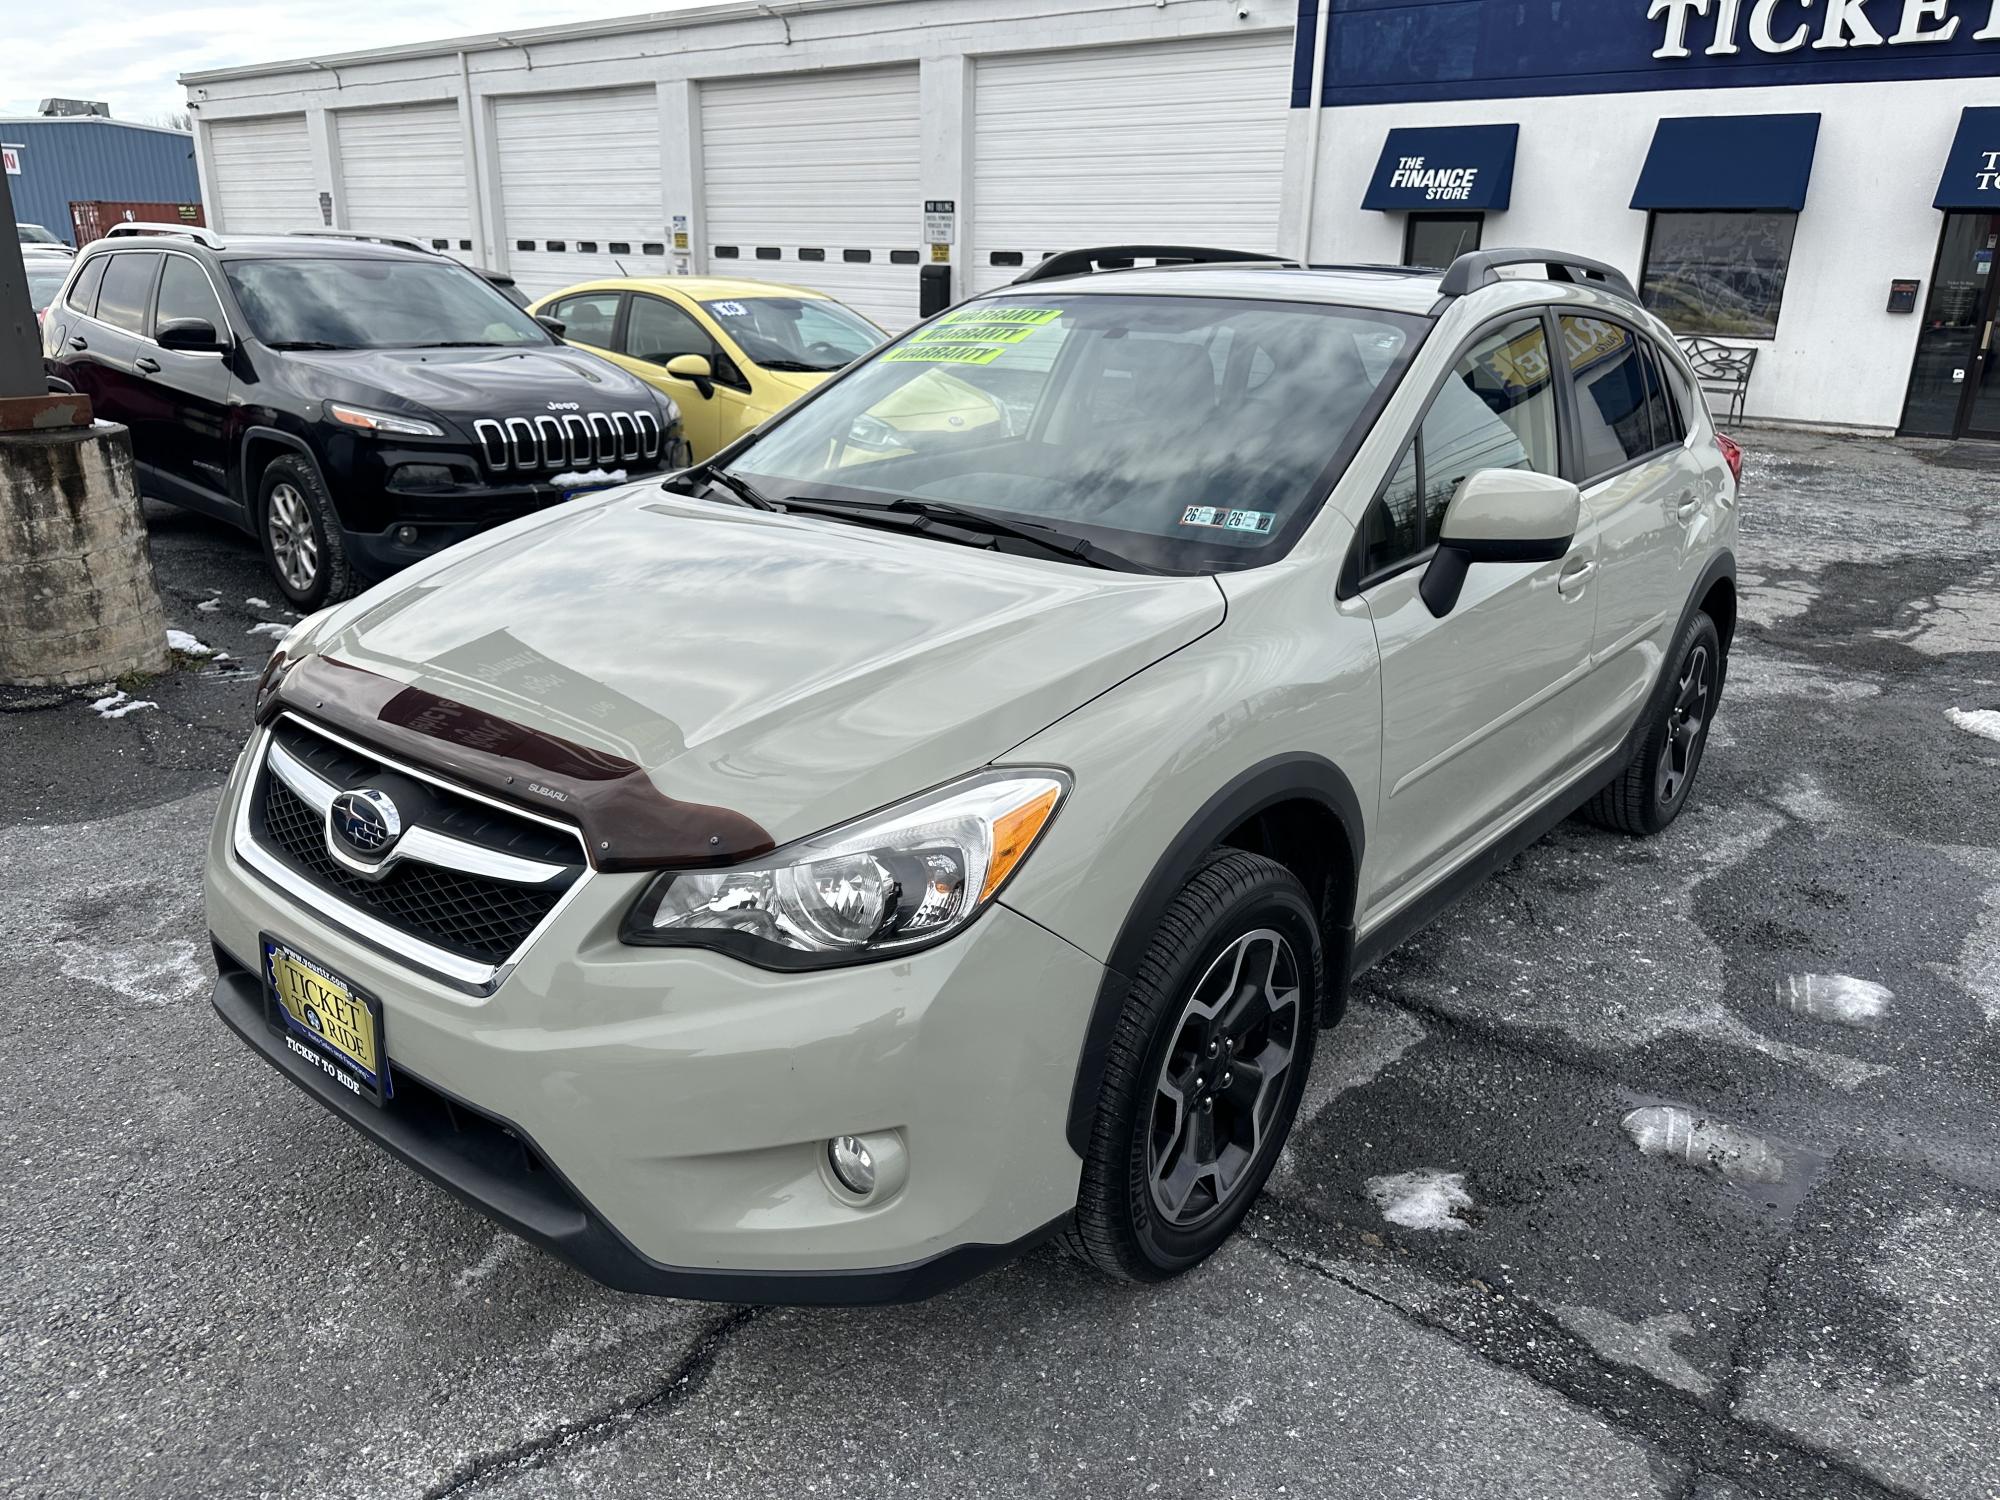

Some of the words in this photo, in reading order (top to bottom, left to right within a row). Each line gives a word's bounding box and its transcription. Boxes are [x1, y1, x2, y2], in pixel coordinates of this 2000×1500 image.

[1399, 157, 1425, 169] THE
[1390, 168, 1478, 188] FINANCE
[1425, 187, 1471, 200] STORE
[949, 309, 1052, 322] WARRANTY
[919, 328, 1020, 342] WARRANTY
[890, 347, 994, 361] WARRANTY
[547, 401, 579, 411] Jeep
[1185, 508, 1199, 522] 26
[1211, 512, 1226, 525] 12
[1229, 512, 1243, 526] 26
[1256, 518, 1270, 531] 12
[528, 783, 569, 802] SUBARU
[282, 945, 349, 992] www.yourttr.com
[285, 963, 361, 1033] TICKET
[325, 1017, 367, 1060] RIDE
[286, 1036, 320, 1067] TICKET
[321, 1059, 336, 1077] TO
[336, 1069, 360, 1095] RIDE
